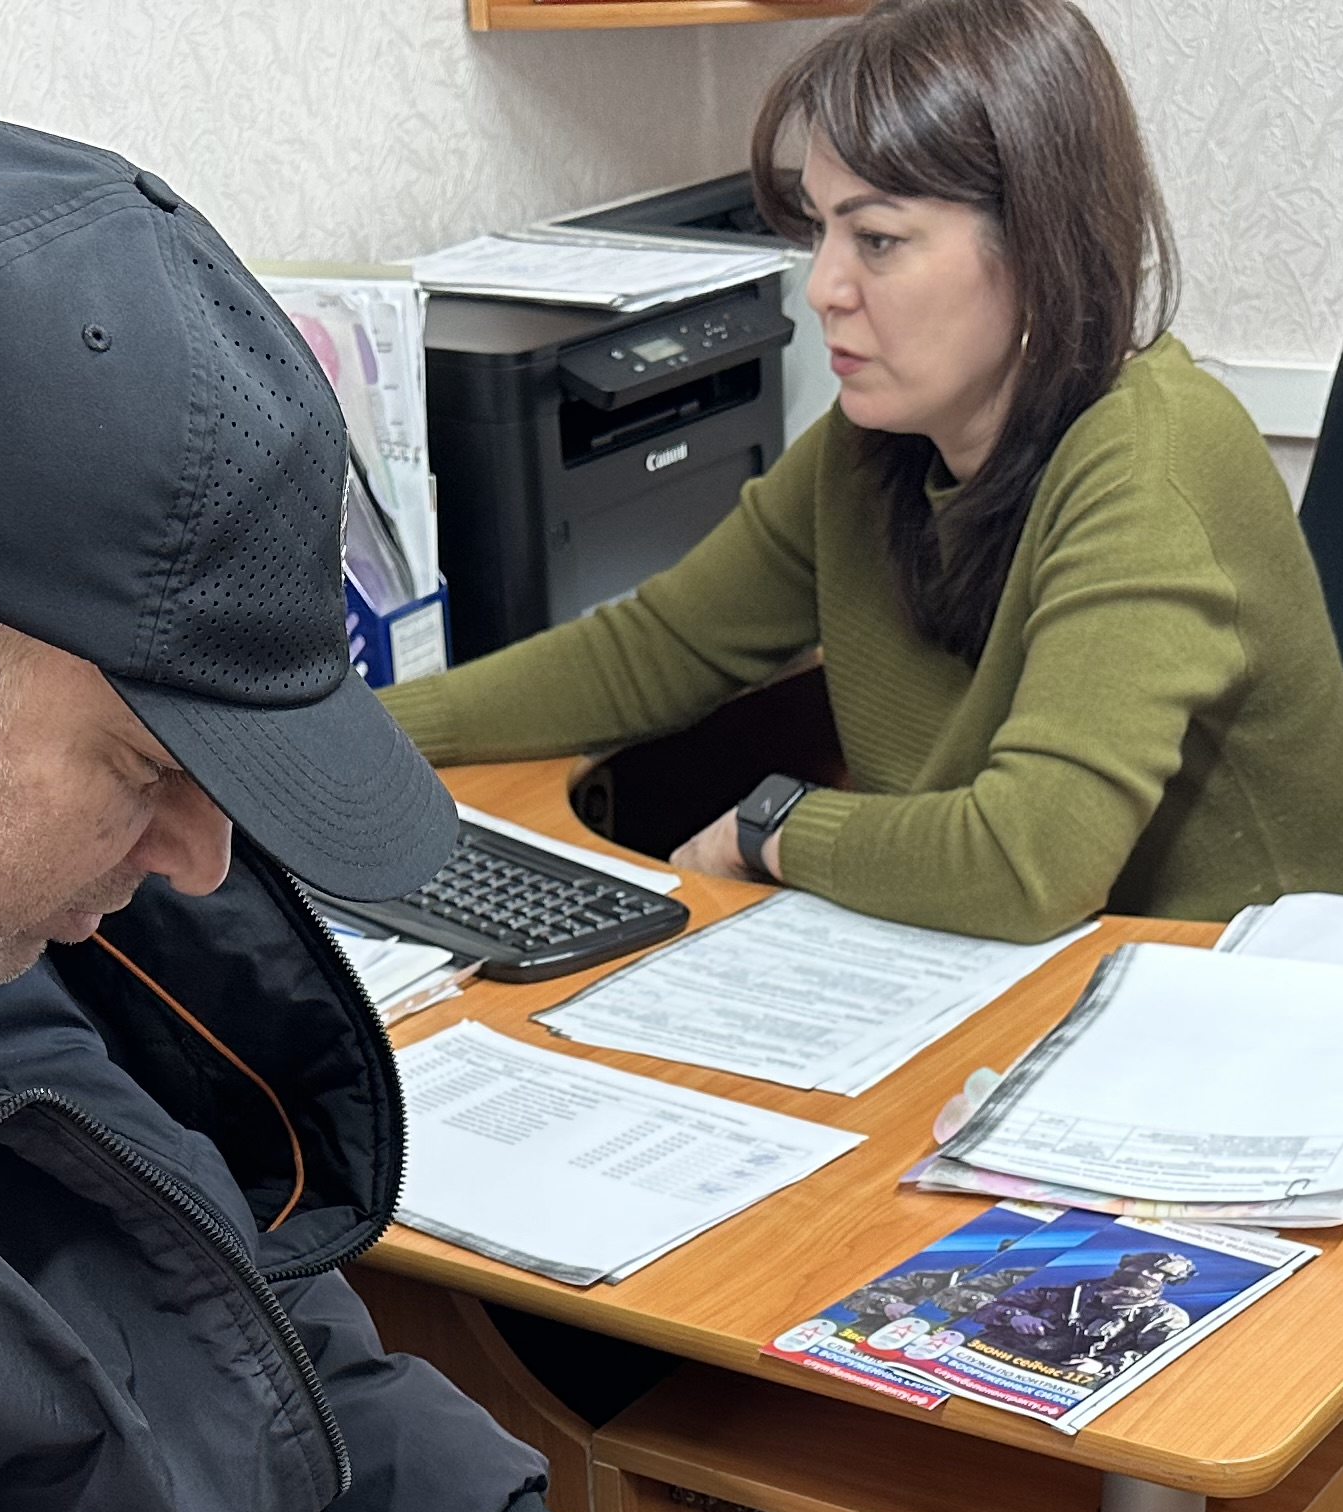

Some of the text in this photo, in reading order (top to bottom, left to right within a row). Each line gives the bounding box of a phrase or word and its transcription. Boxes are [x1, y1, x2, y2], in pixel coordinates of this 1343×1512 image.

[938, 1353, 1078, 1409] В ВООРУЖЕННЫХ СИЛАХ
[956, 1349, 1080, 1402] СЛУЖИ ПО КОНТРАКТУ
[966, 1340, 1095, 1388] Звони сейчас 117
